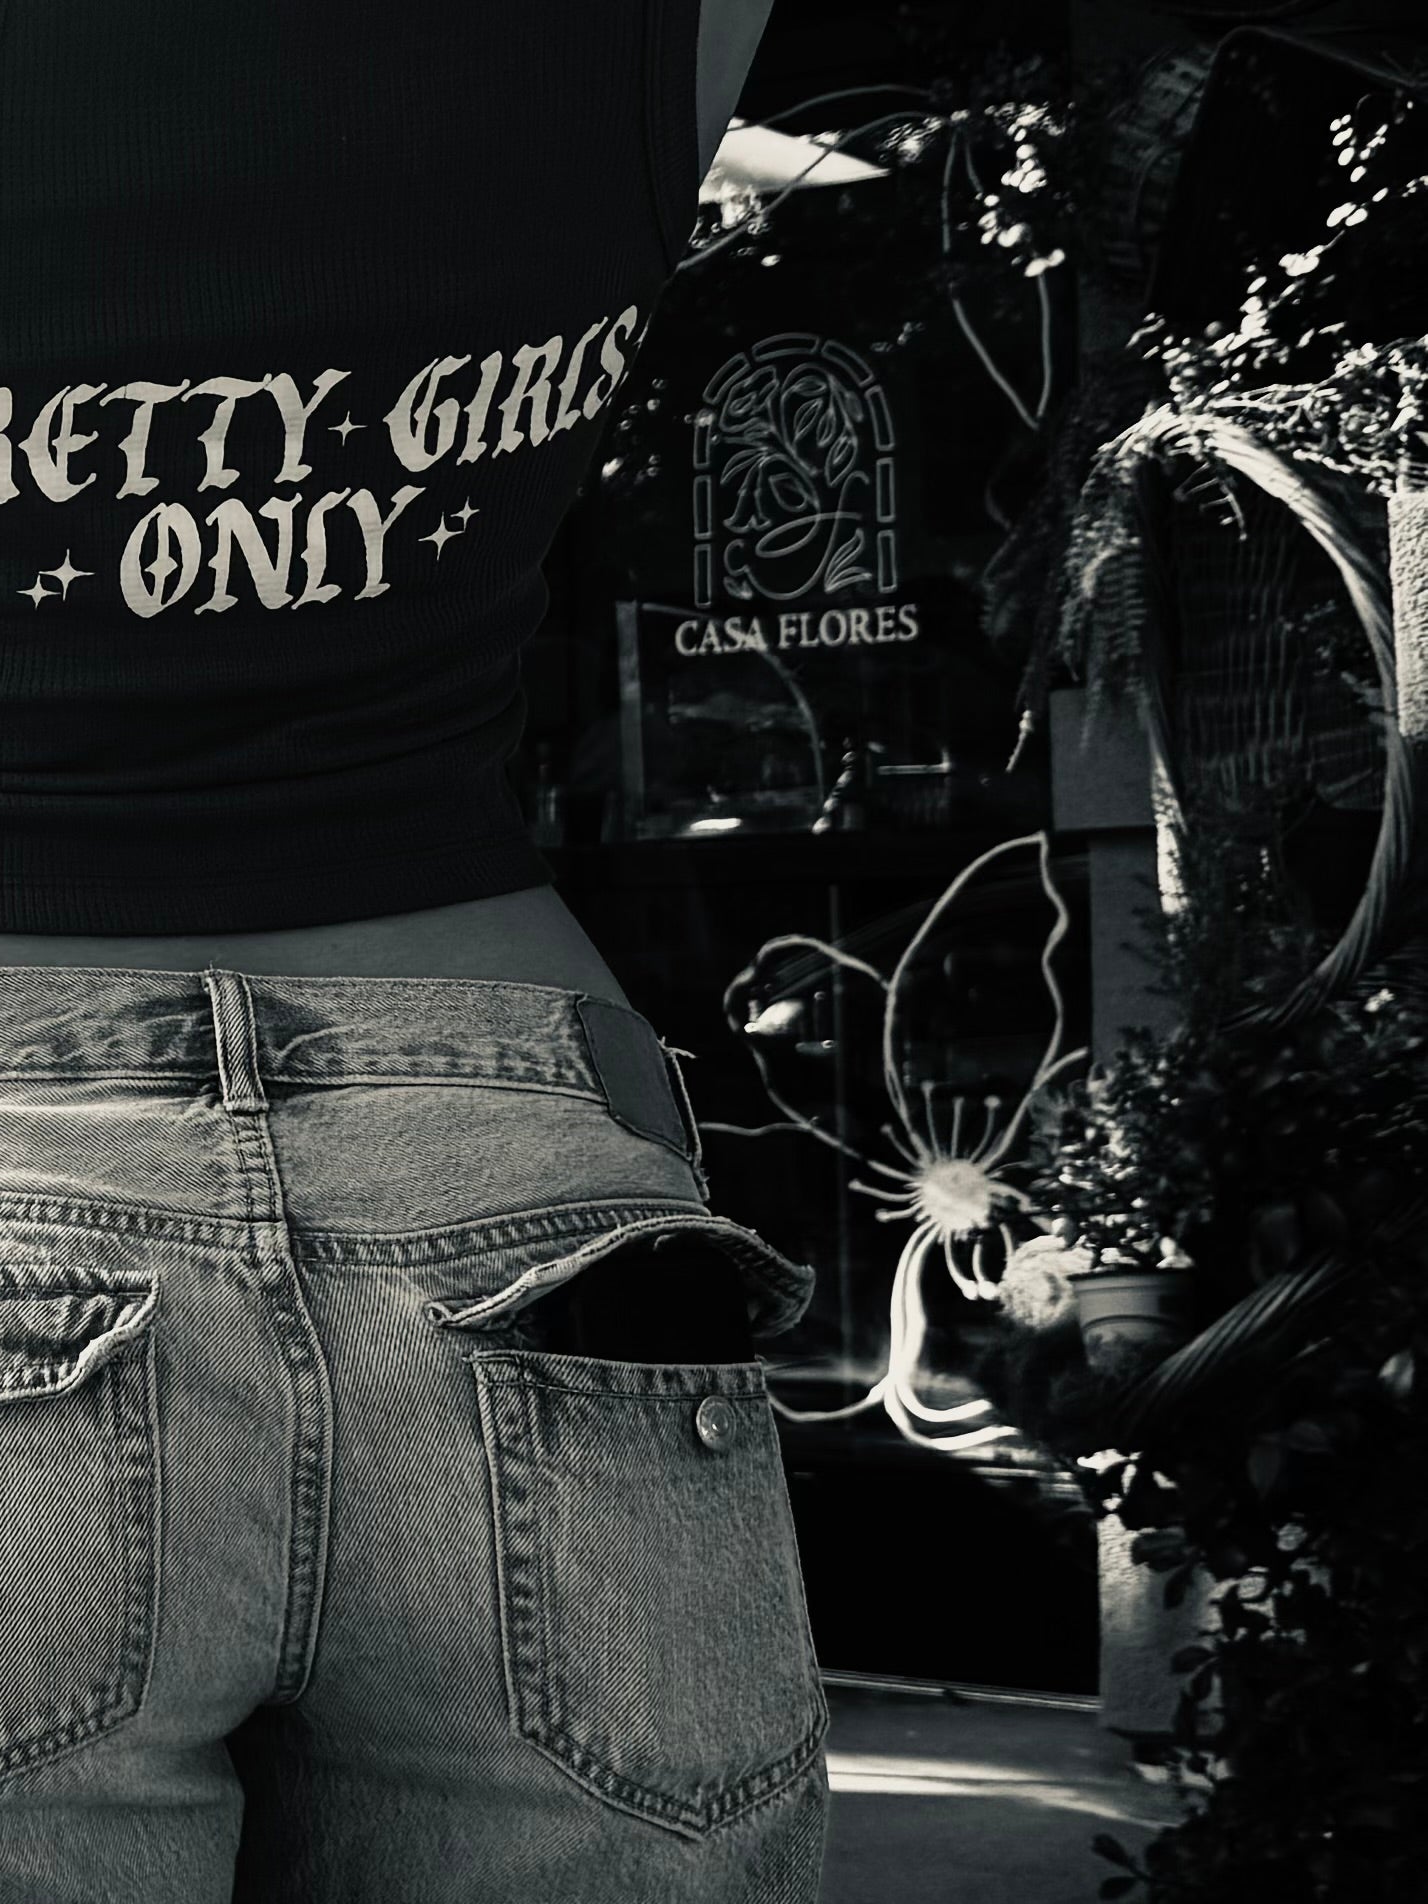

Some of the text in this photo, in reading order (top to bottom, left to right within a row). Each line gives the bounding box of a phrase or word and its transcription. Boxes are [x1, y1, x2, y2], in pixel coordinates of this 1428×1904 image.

[381, 304, 640, 473] GIRLS
[119, 486, 426, 619] ONLY
[673, 602, 921, 657] CASA FLORES
